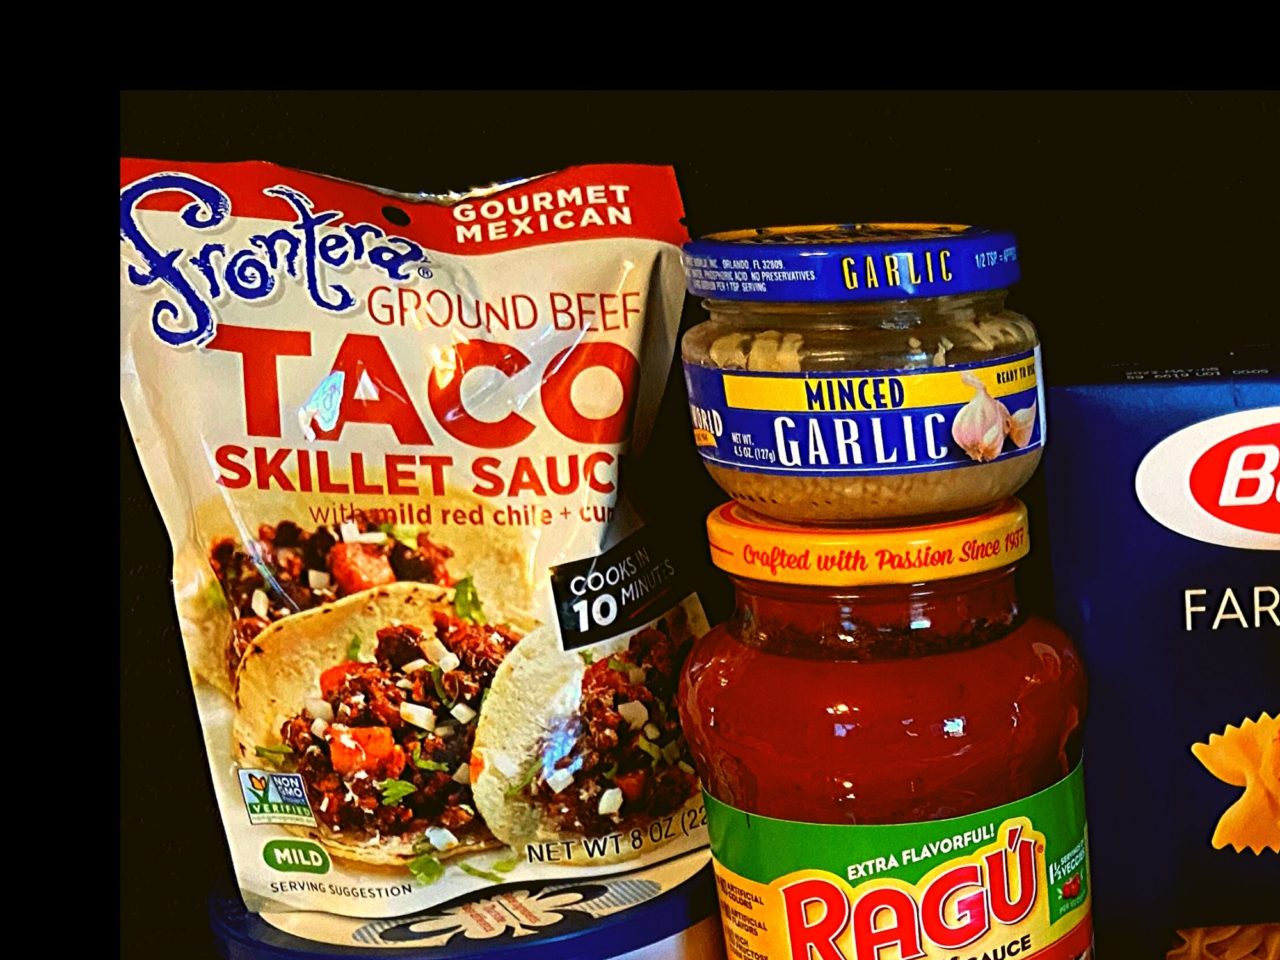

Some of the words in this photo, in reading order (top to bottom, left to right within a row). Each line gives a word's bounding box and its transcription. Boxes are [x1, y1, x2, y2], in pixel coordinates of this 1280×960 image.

[452, 184, 630, 222] GOURMET
[456, 206, 633, 244] MEXICAN
[762, 270, 816, 281] PRESERVATIVES
[841, 250, 953, 290] GARLIC
[367, 285, 538, 333] GROUND
[551, 291, 642, 333] BEEF
[206, 323, 641, 450] TACO
[804, 377, 905, 411] MINCED
[996, 369, 1018, 385] READY
[774, 411, 949, 468] GARLIC
[216, 445, 454, 498] SKILLET
[310, 503, 365, 524] with
[372, 503, 432, 525] mild
[442, 504, 485, 525] red
[492, 505, 552, 527] chile
[570, 557, 637, 596] COOKS
[636, 548, 650, 568] IN
[743, 544, 810, 576] Crafted
[816, 549, 869, 572] with
[876, 546, 953, 570] Passion
[959, 537, 1000, 562] Since
[573, 594, 618, 632] 10
[274, 776, 299, 787] NON
[253, 804, 311, 816] VERIFIED
[274, 848, 323, 866] MILD
[527, 841, 573, 863] NET
[582, 835, 622, 859] WT
[630, 831, 642, 850] 8
[648, 817, 677, 843] OZ
[847, 854, 899, 881] EXTRA
[901, 823, 996, 866] FLAVORFUL!
[271, 881, 326, 893] SERVING
[328, 884, 412, 898] SUGGESTION
